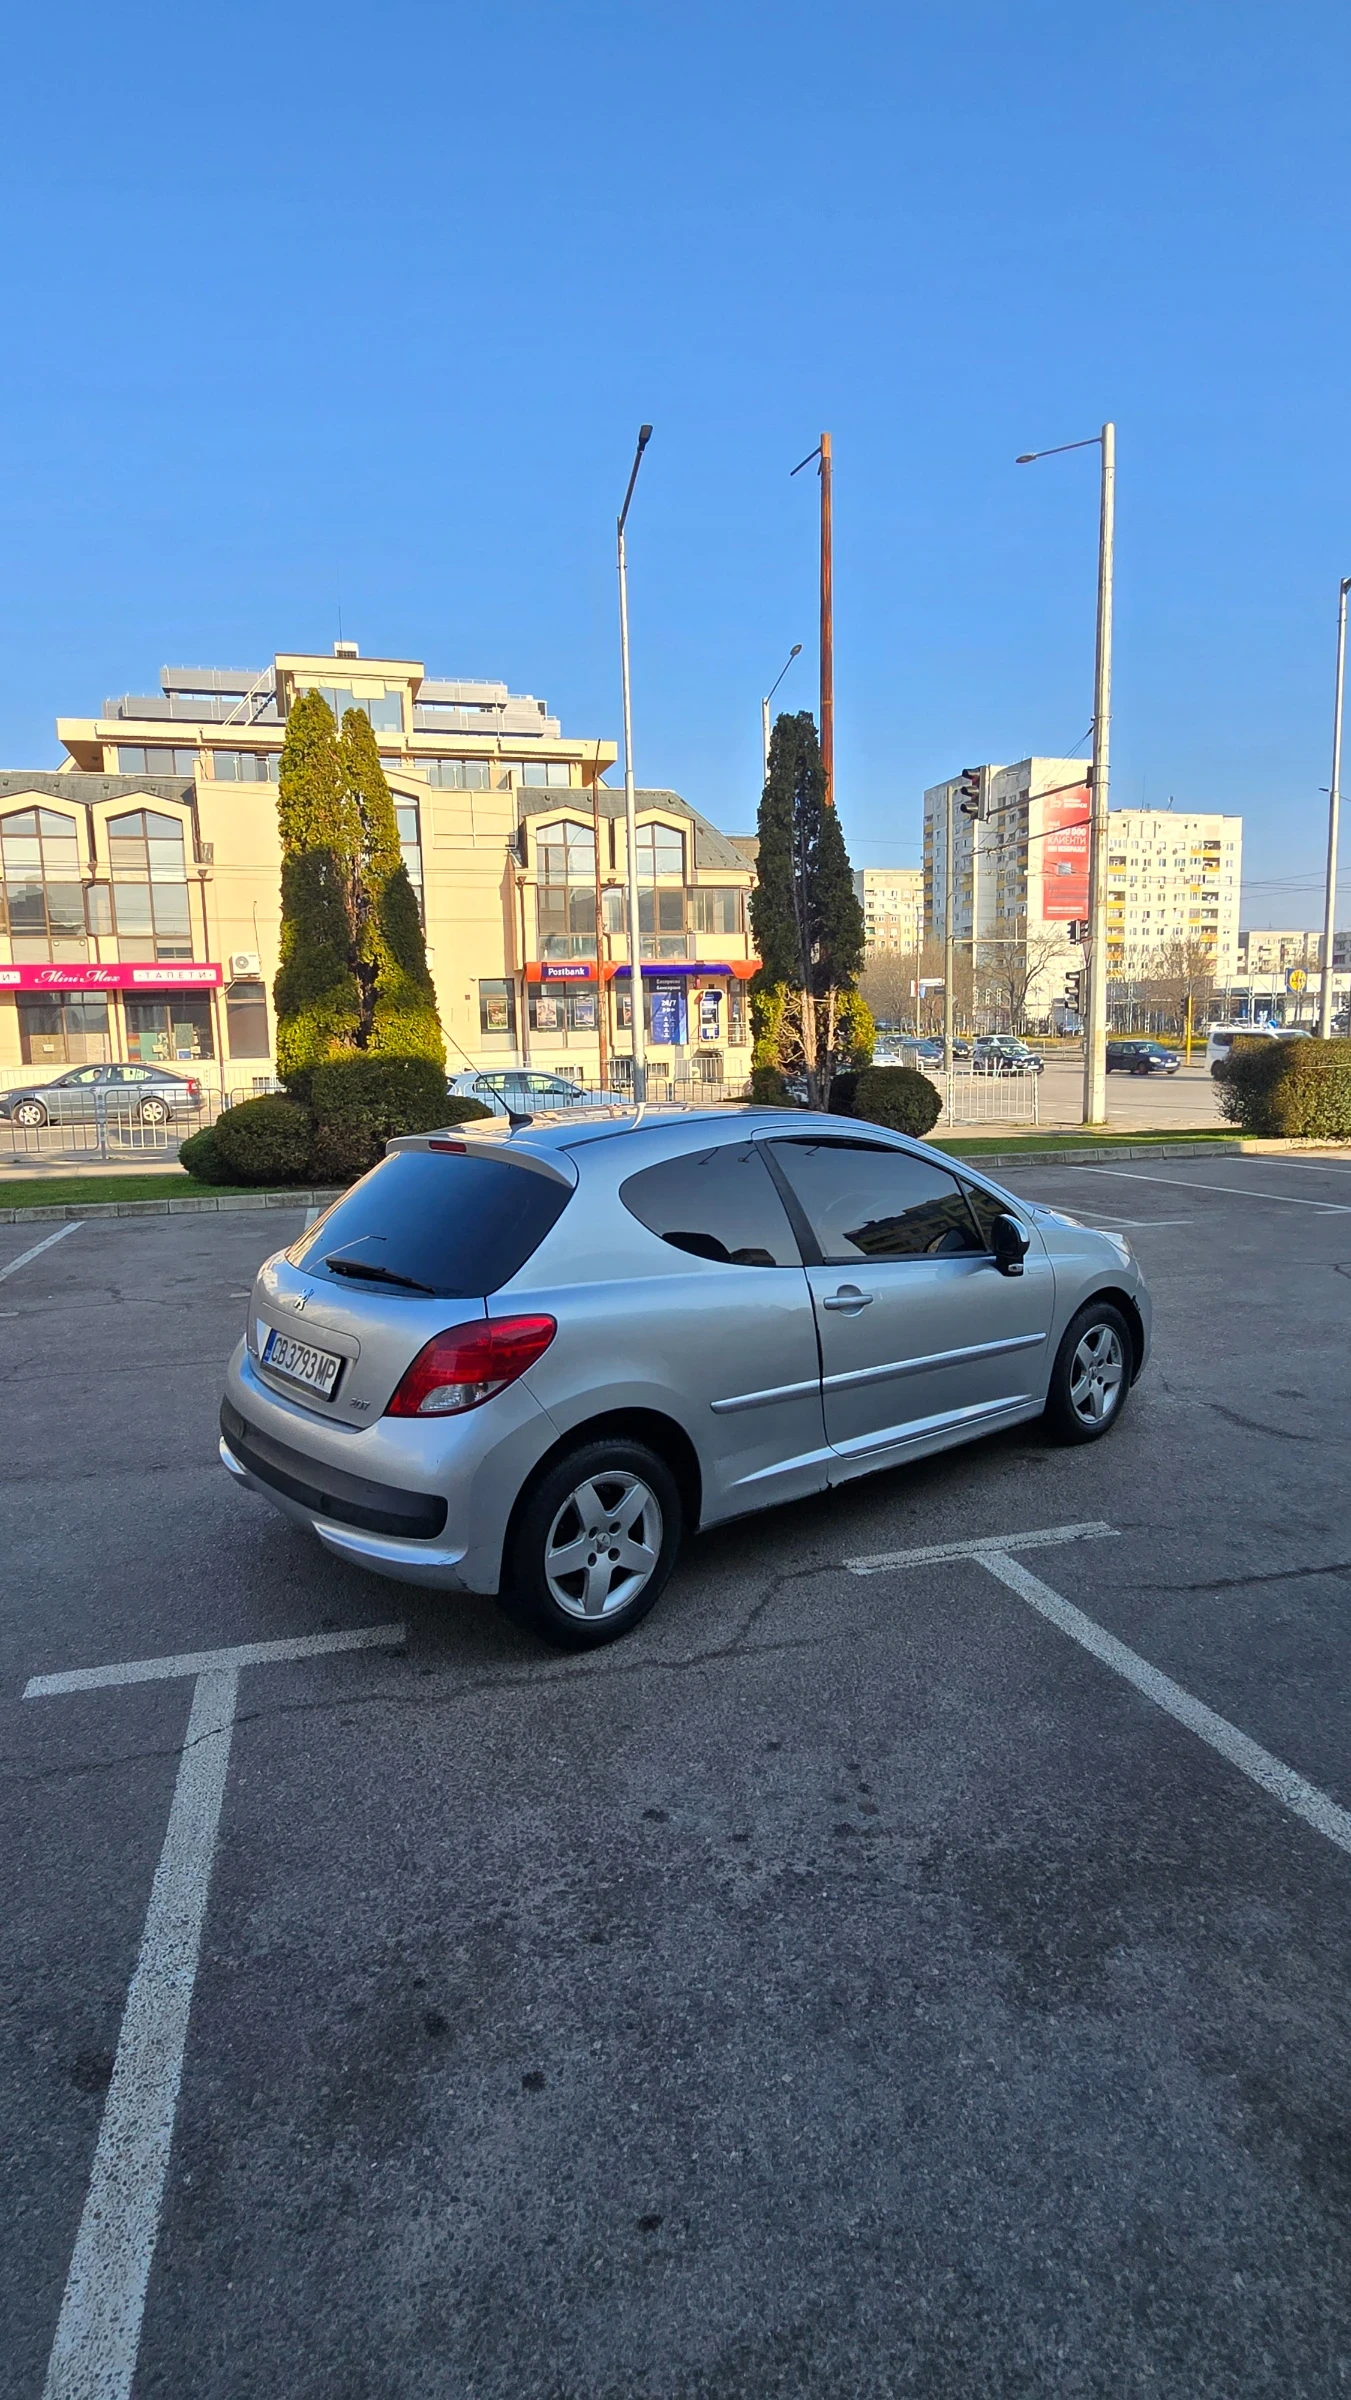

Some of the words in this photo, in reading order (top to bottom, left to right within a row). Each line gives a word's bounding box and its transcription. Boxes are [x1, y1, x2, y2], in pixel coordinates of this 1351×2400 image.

[34, 970, 79, 984] Mini
[79, 969, 121, 983] Max
[144, 971, 207, 979] ТАПЕТИ
[548, 967, 585, 976] Postbank
[349, 1397, 371, 1411] 207
